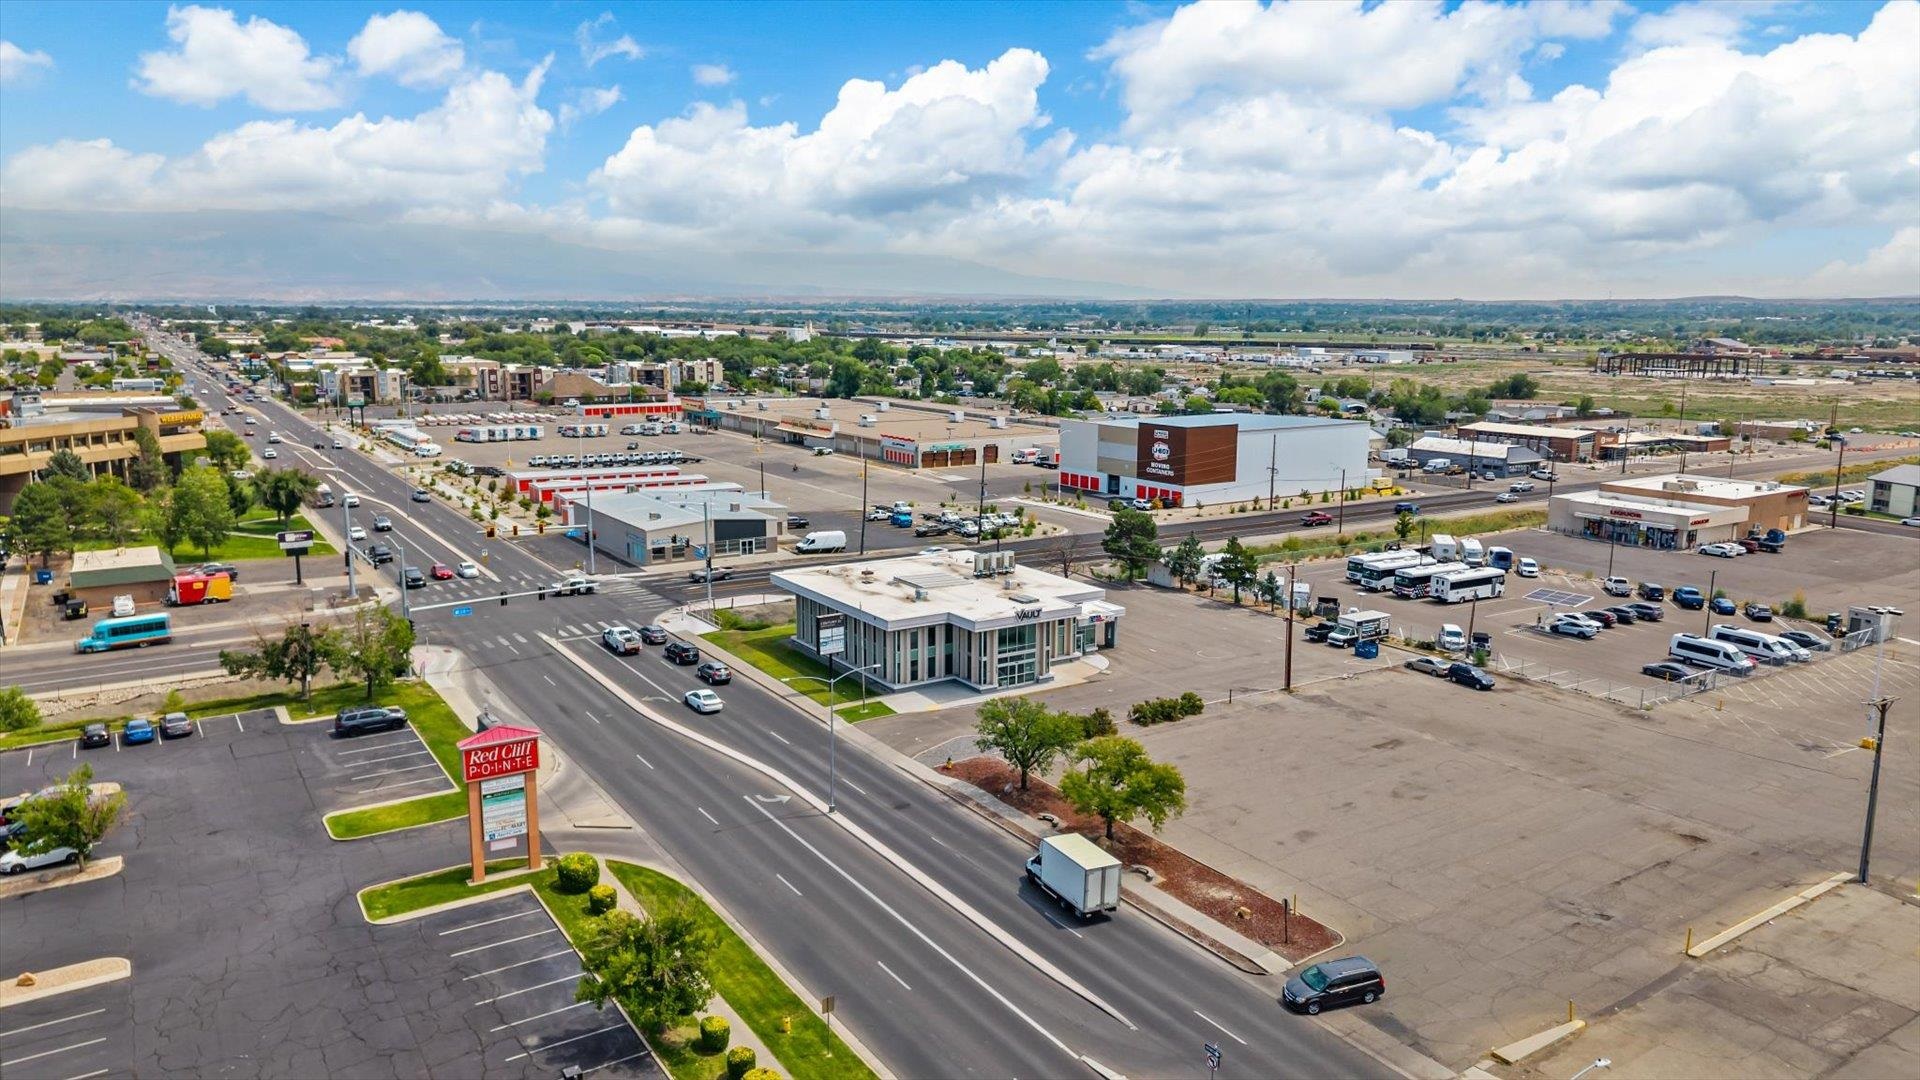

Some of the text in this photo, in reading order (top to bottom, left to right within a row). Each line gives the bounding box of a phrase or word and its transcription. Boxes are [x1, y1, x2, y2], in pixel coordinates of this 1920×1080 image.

[1016, 607, 1043, 621] VAULT
[469, 740, 534, 766] Red Cliff
